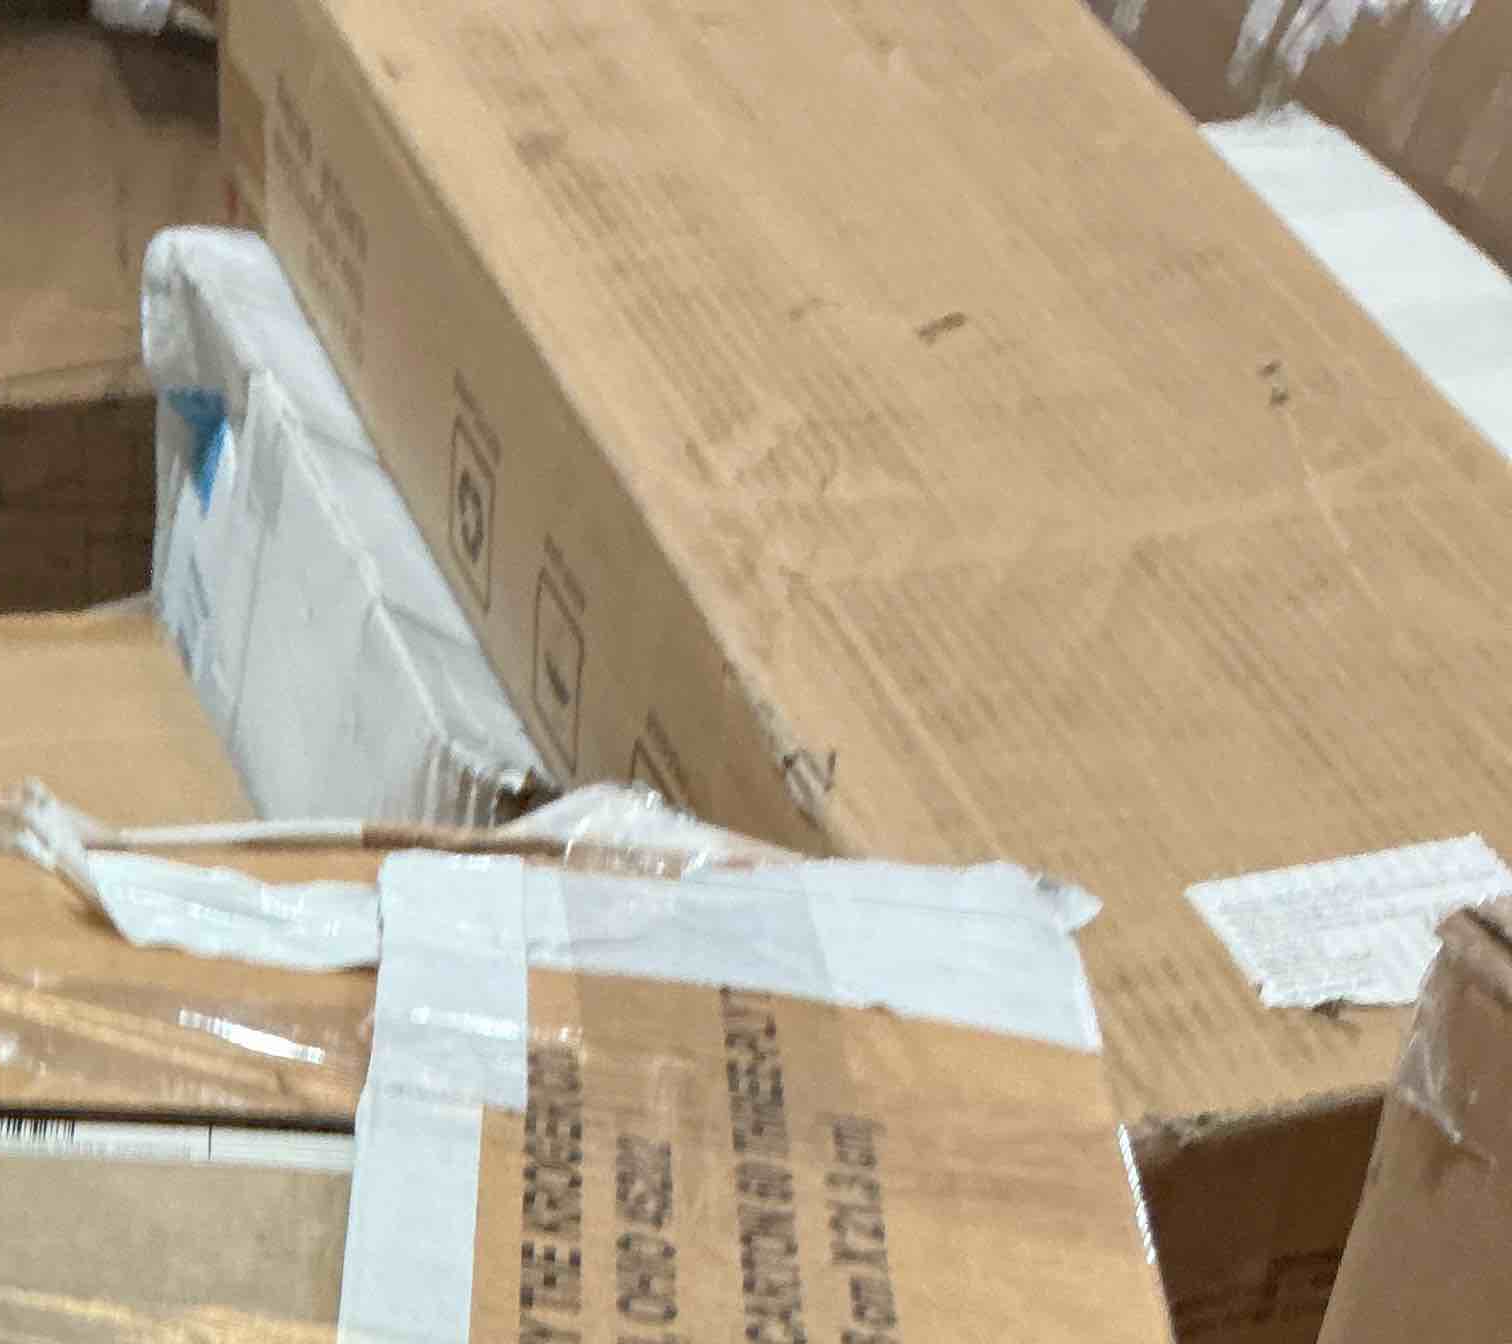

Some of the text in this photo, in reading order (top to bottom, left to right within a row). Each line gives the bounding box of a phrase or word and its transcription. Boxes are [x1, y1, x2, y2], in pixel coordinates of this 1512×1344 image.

[522, 1100, 582, 1236] KROGER
[521, 1241, 581, 1310] THE
[618, 1231, 677, 1324] OHIO
